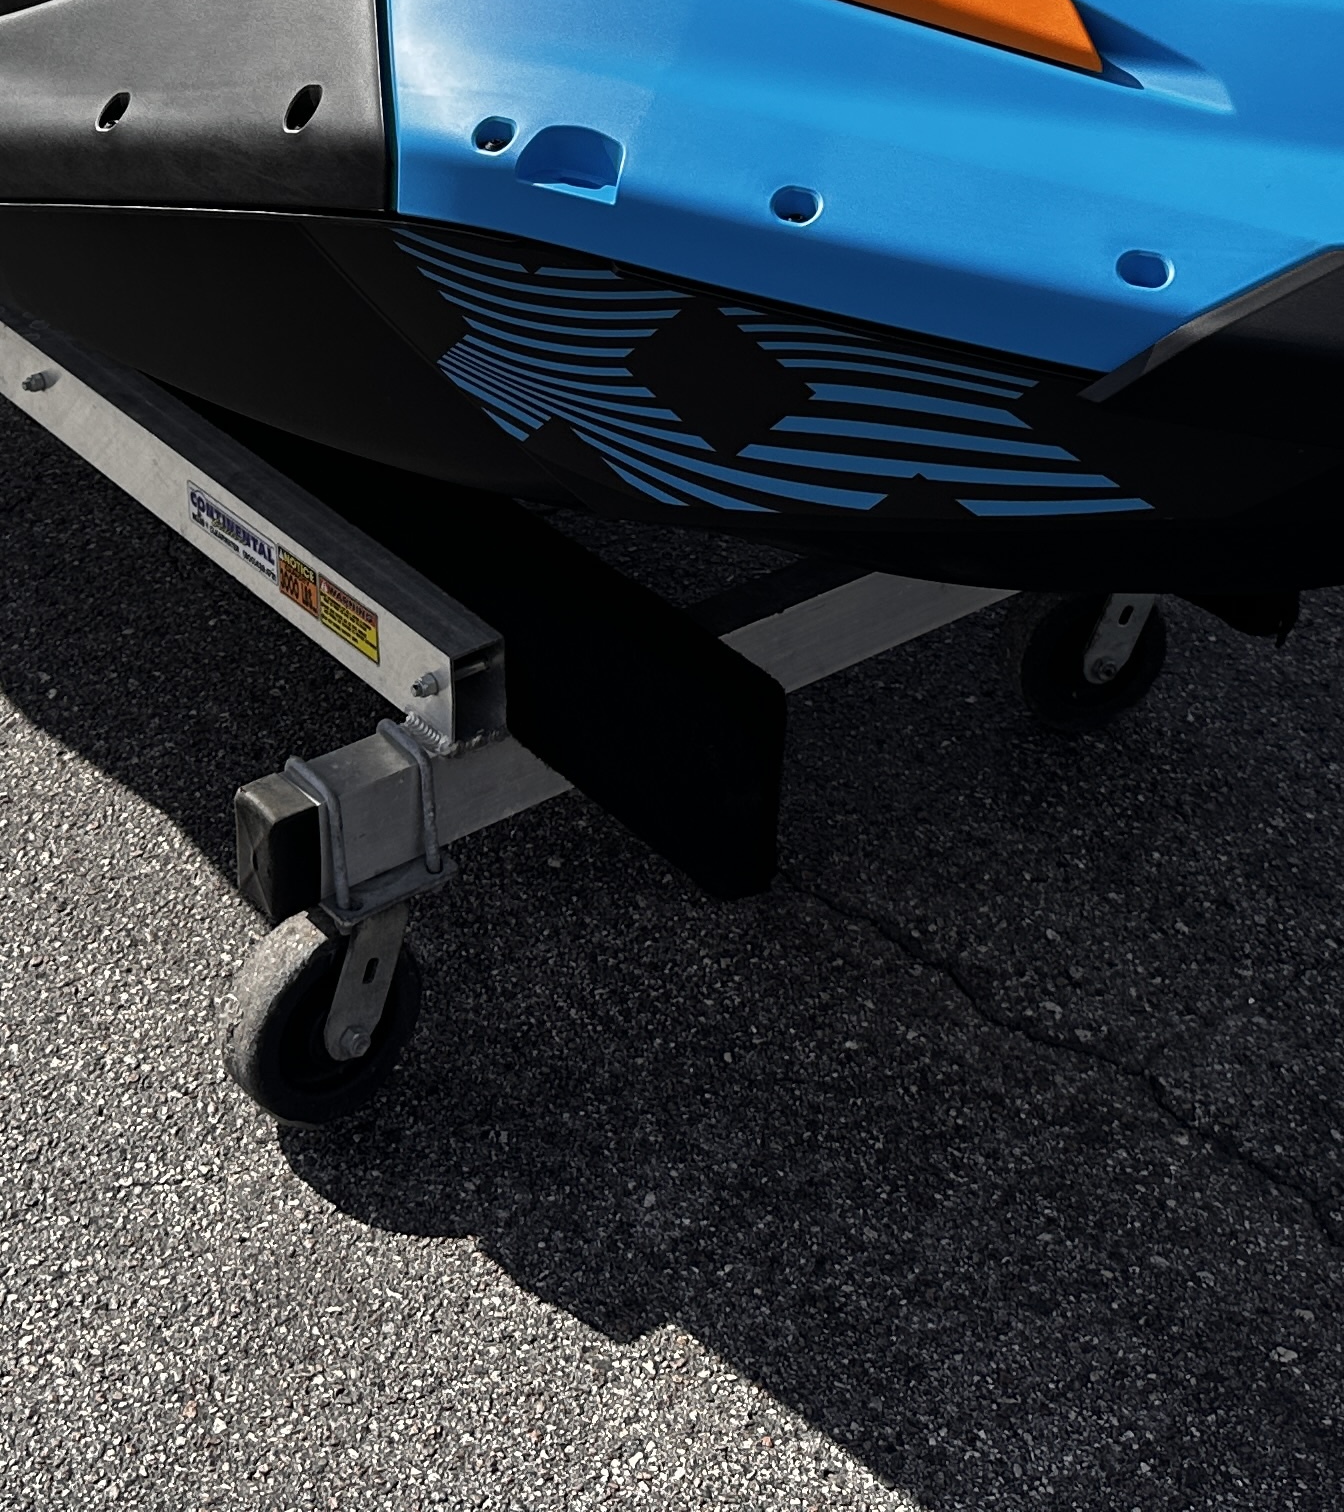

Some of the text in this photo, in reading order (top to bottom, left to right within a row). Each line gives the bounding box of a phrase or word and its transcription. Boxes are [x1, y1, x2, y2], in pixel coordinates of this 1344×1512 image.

[190, 491, 275, 566] CONTINENTAL
[282, 551, 315, 584] NOTICE
[327, 584, 374, 624] WARNING
